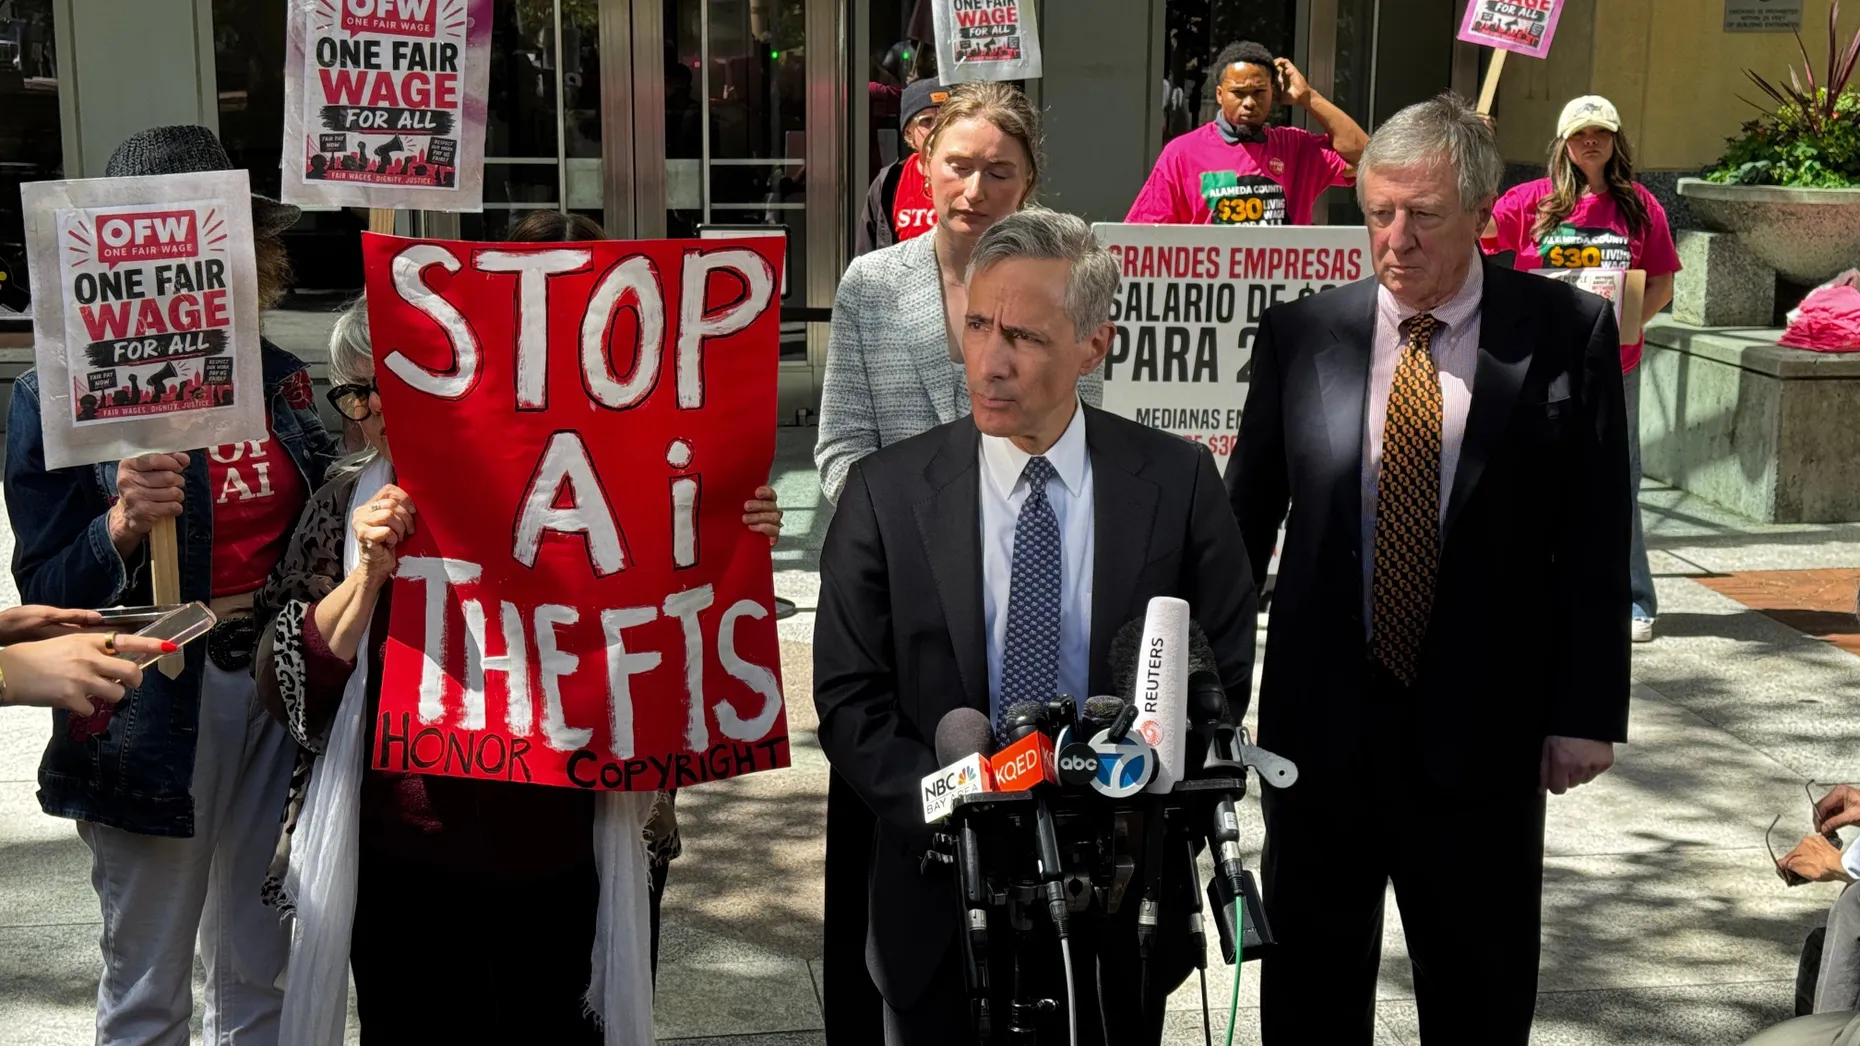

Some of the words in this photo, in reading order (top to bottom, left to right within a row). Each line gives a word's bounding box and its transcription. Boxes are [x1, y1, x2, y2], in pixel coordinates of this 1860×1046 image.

[348, 0, 429, 21] OFW
[954, 0, 982, 11] ONE
[956, 6, 1018, 28] WAGE
[1495, 3, 1515, 15] FOR
[1517, 7, 1538, 19] ALL
[347, 17, 368, 27] ONE
[373, 19, 396, 28] FAIR
[401, 23, 430, 32] WAGE
[969, 27, 988, 37] FOR
[992, 24, 1010, 35] ALL
[316, 37, 381, 69] ONE
[392, 41, 458, 72] FAIR
[318, 69, 458, 109] WAGE
[345, 109, 388, 129] FOR
[397, 110, 436, 129] ALL
[331, 171, 346, 179] FAIR
[1209, 185, 1252, 198] ALAMEDA
[1253, 184, 1283, 193] COUNTY
[1218, 197, 1263, 221] $30
[1263, 199, 1286, 210] LIVING
[1263, 210, 1285, 220] WAGE
[102, 216, 189, 247] OFW
[1591, 233, 1629, 245] COUNTY
[104, 247, 127, 257] ONE
[132, 246, 157, 255] FAIR
[161, 244, 192, 253] WAGE
[1550, 245, 1600, 268] $30
[1229, 247, 1362, 280] EMPRESAS
[74, 268, 145, 305] ONE
[155, 258, 226, 296] FAIR
[79, 290, 230, 341] WAGE
[383, 244, 777, 412] STOP
[113, 340, 159, 363] FOR
[168, 332, 209, 355] ALL
[1104, 326, 1219, 383] PARA
[95, 379, 110, 387] NOW
[103, 408, 119, 417] FAIR
[1136, 407, 1221, 430] MEDIANAS
[217, 462, 275, 504] AI
[512, 429, 702, 579] Ai
[393, 555, 783, 760] THEFTS
[1145, 637, 1164, 713] REUTERS
[380, 711, 532, 781] HONOR
[566, 735, 788, 789] COPYRIGHT
[995, 749, 1037, 785] KQED
[1060, 755, 1098, 771] abc
[925, 772, 956, 802] NBC
[926, 797, 947, 815] BAY
